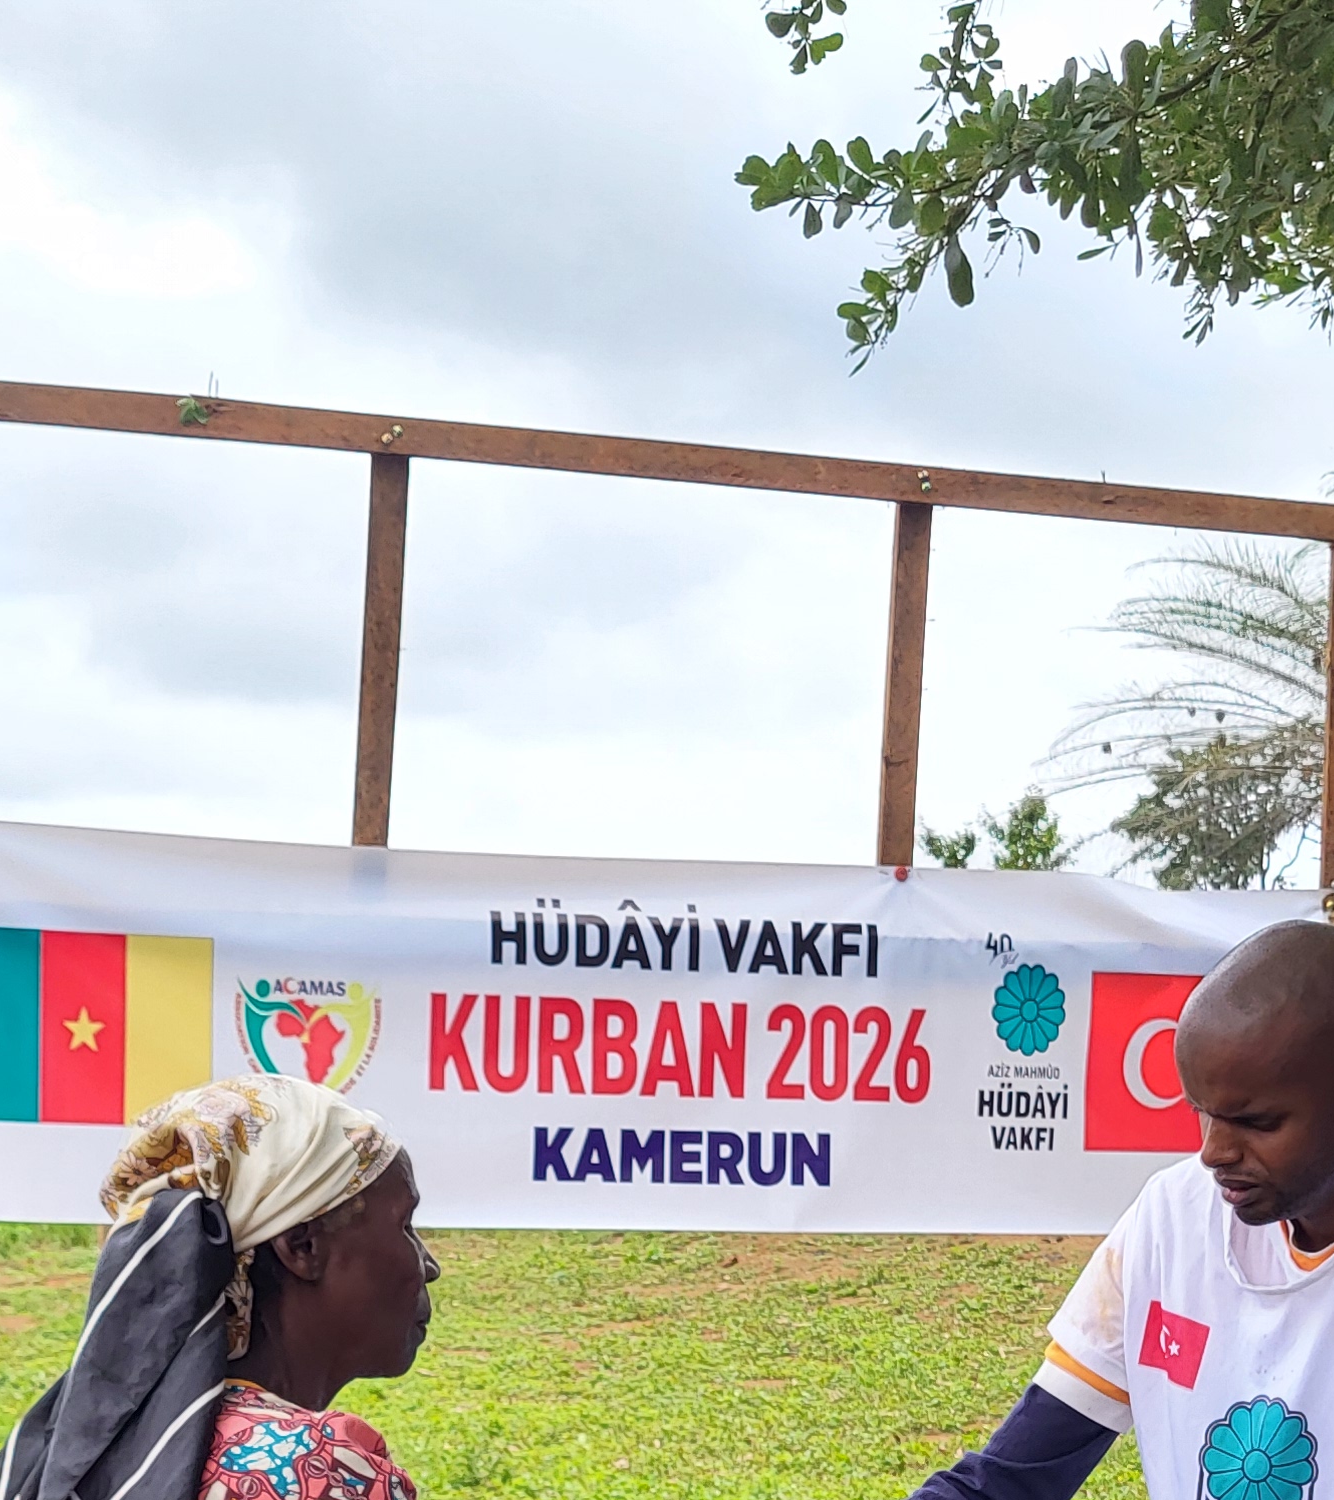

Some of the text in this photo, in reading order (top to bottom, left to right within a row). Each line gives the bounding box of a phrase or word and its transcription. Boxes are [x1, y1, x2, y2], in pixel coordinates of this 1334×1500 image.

[489, 898, 879, 978] HÜDÂYİ VAKFI
[985, 931, 1015, 958] 40
[273, 977, 347, 997] ACAMAS
[428, 992, 931, 1104] KURBAN 2026
[978, 1082, 1069, 1120] HÜDÂYİ
[532, 1126, 832, 1187] KAMERUN
[990, 1125, 1055, 1151] VAKFI
